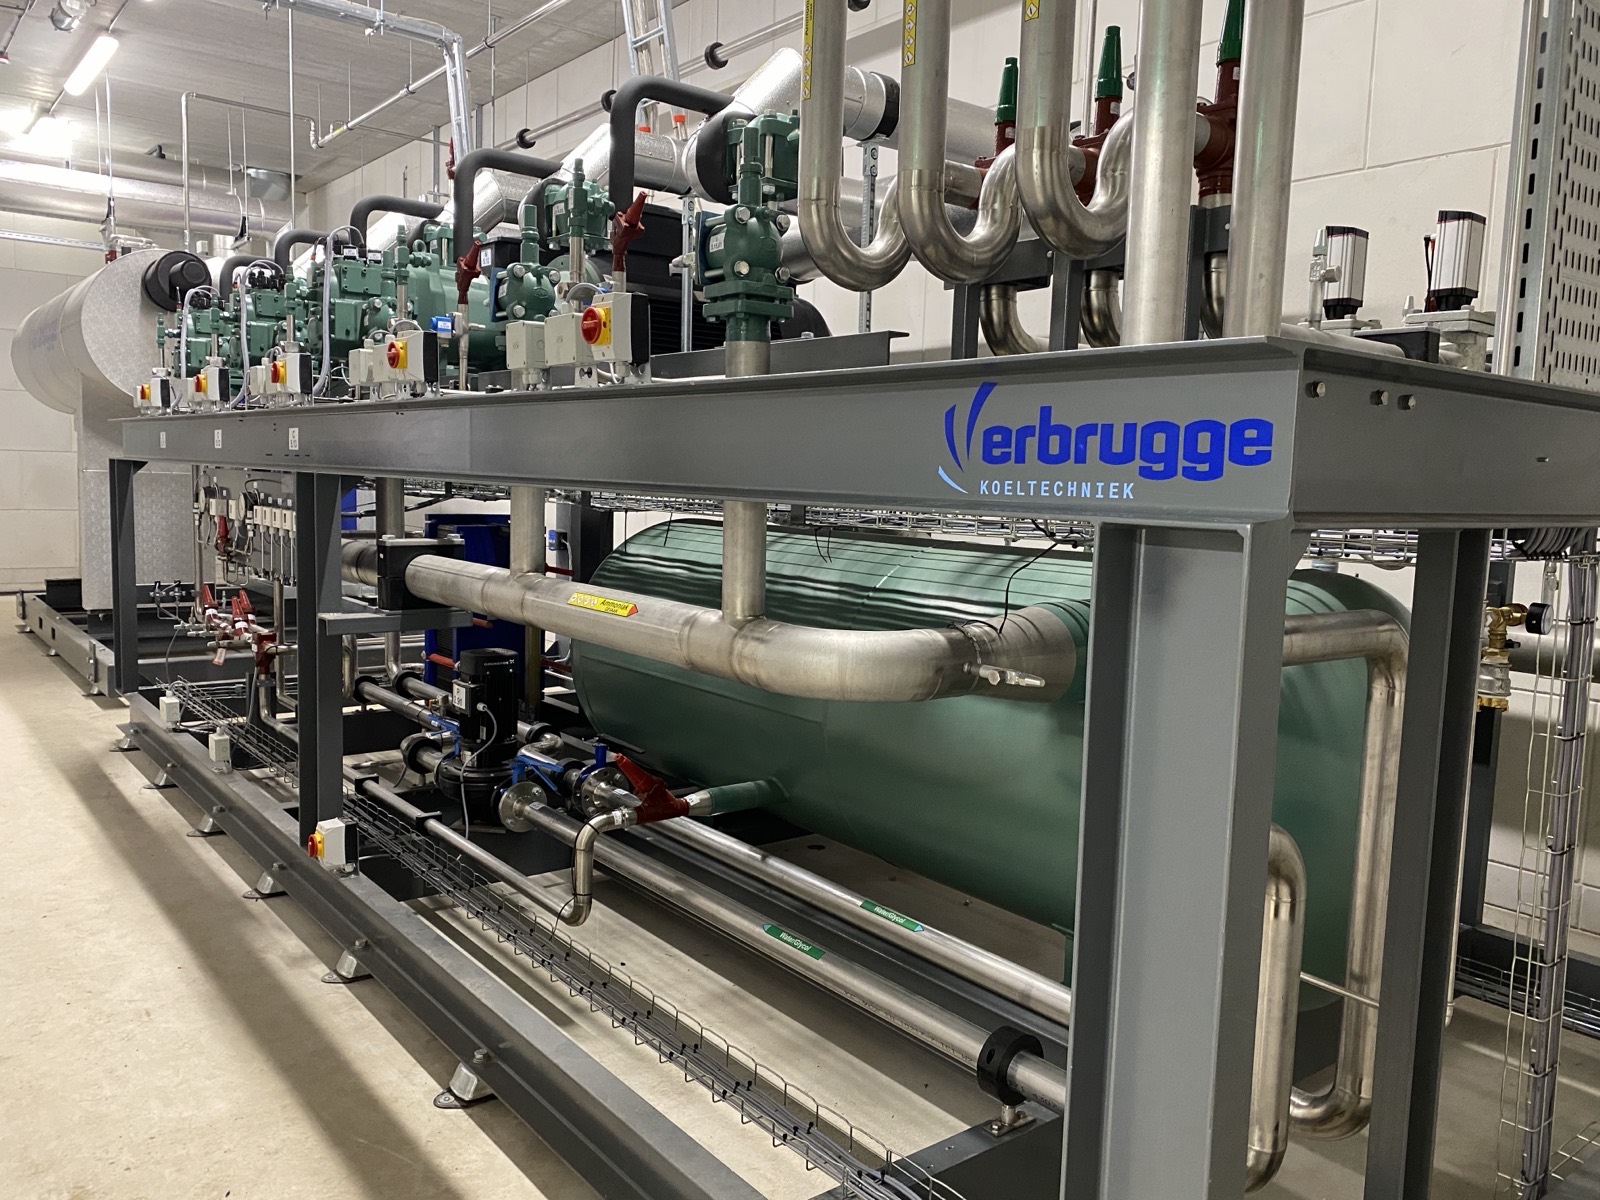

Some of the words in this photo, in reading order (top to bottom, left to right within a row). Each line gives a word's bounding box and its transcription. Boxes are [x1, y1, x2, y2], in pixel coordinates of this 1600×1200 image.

[944, 381, 1274, 481] Verbrugge
[979, 480, 1134, 499] KOELTECHNIEK
[600, 600, 629, 611] Ammoniak
